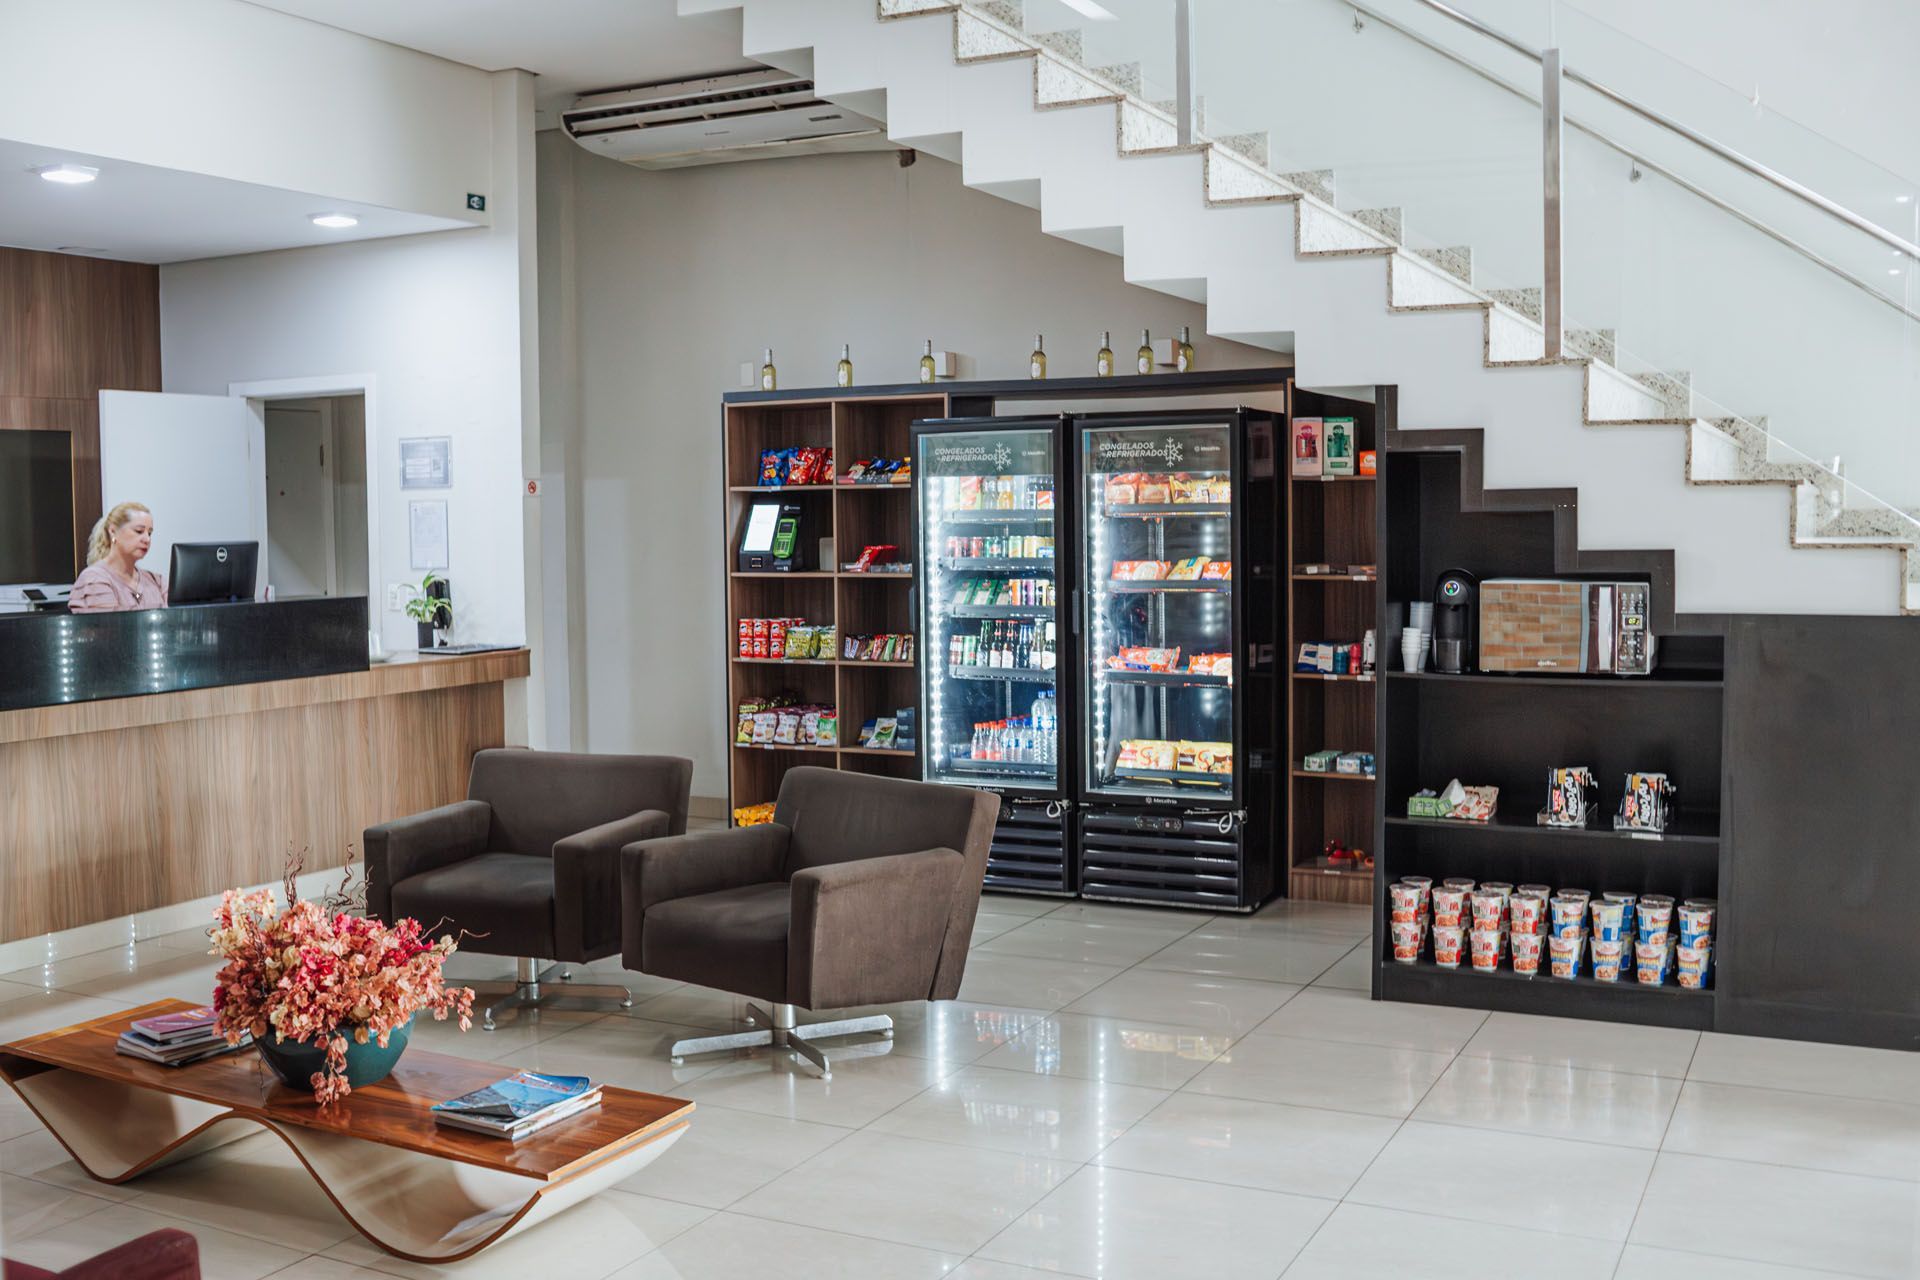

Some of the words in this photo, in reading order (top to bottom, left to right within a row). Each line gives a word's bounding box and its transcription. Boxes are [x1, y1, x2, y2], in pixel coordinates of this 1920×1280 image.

[934, 446, 985, 456] CONGELADOS
[1099, 442, 1154, 451] CONGELADOS
[941, 453, 998, 462] REFRIGERADOS
[1105, 449, 1168, 458] REFRIGERADOS
